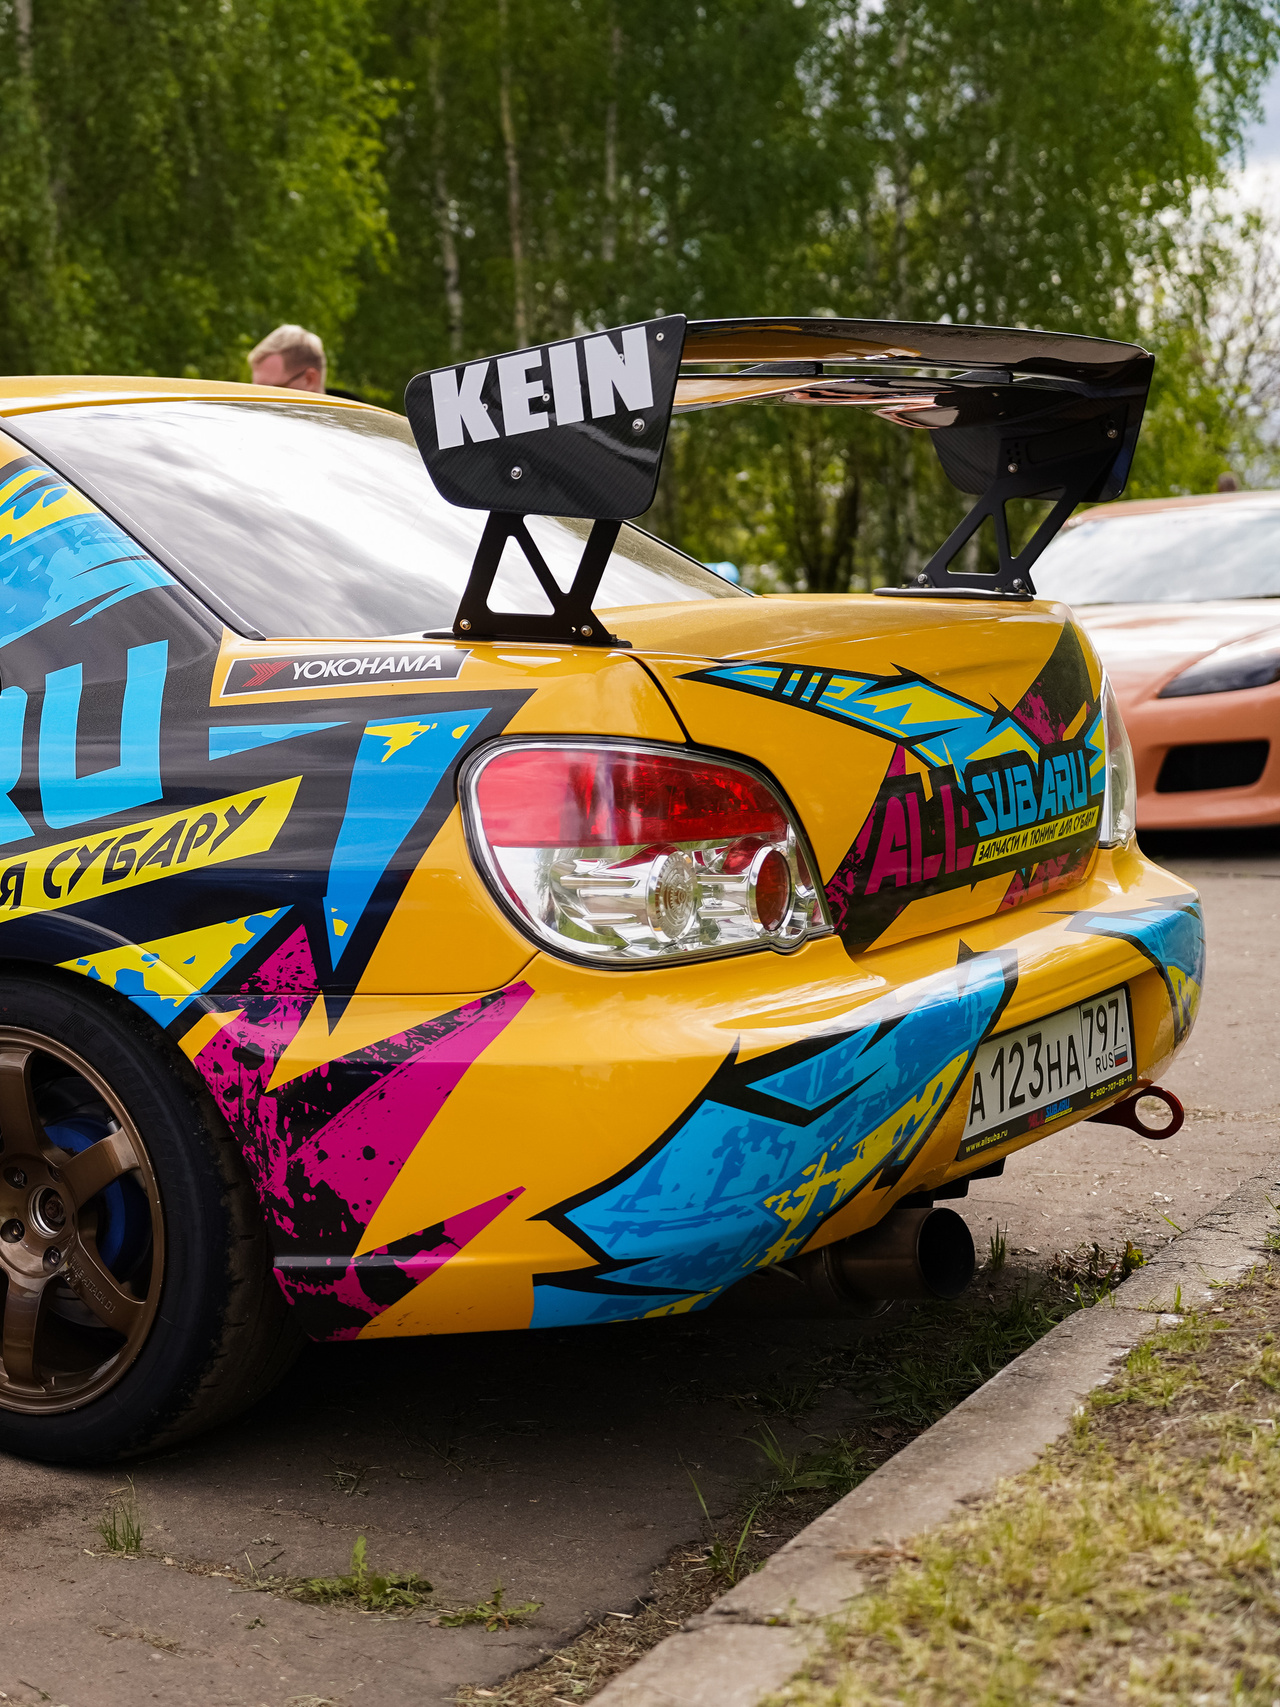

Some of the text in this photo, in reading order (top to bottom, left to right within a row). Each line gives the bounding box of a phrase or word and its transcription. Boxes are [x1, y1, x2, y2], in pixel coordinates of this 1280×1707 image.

[429, 325, 655, 451] KEIN
[292, 654, 442, 681] YOKOHAMA
[42, 795, 268, 900] СУБАРУ
[864, 749, 1089, 895] ALL SUBARU
[978, 808, 1097, 862] ЗАПЧАСТИ И ТЮНИНГ ДЛЯ СУБАРУ
[1082, 998, 1120, 1059] 797
[1095, 1051, 1115, 1075] RUS
